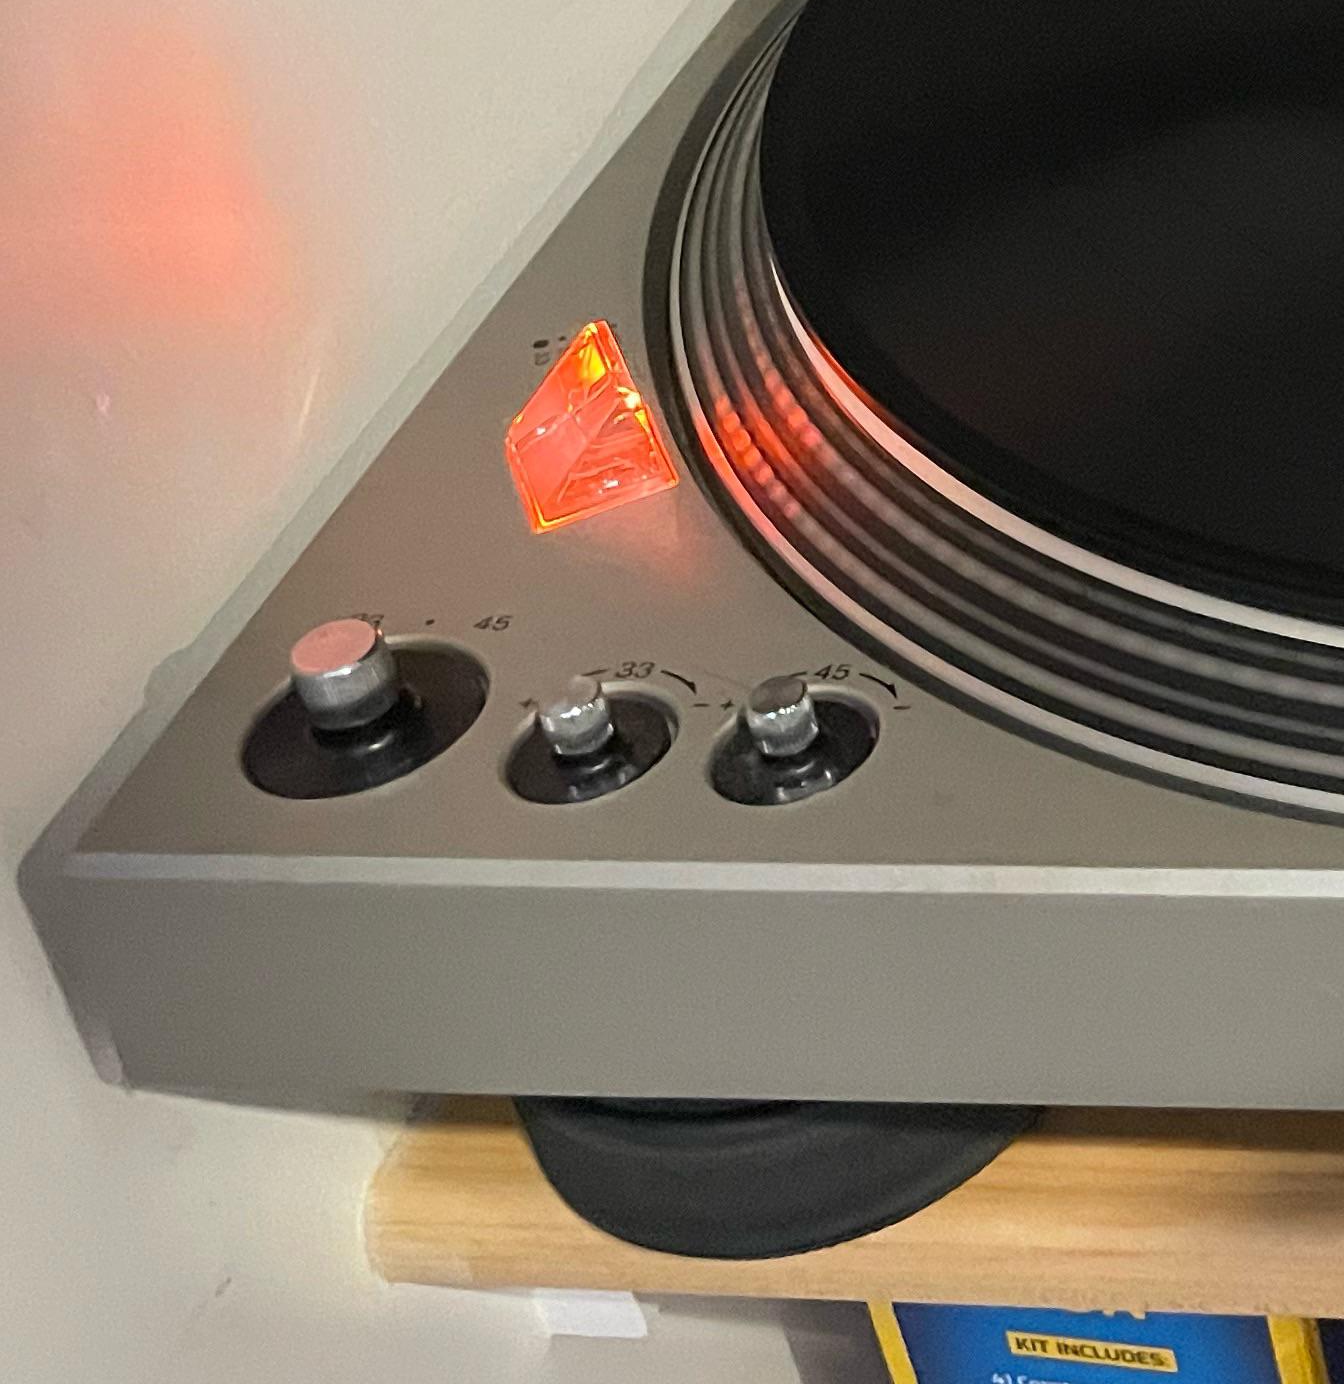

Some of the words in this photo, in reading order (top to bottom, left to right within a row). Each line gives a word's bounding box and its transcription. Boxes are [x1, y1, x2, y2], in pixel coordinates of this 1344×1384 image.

[472, 615, 514, 632] 45
[614, 661, 656, 679] 33
[813, 663, 851, 681] 45
[1015, 1336, 1048, 1354] KIT
